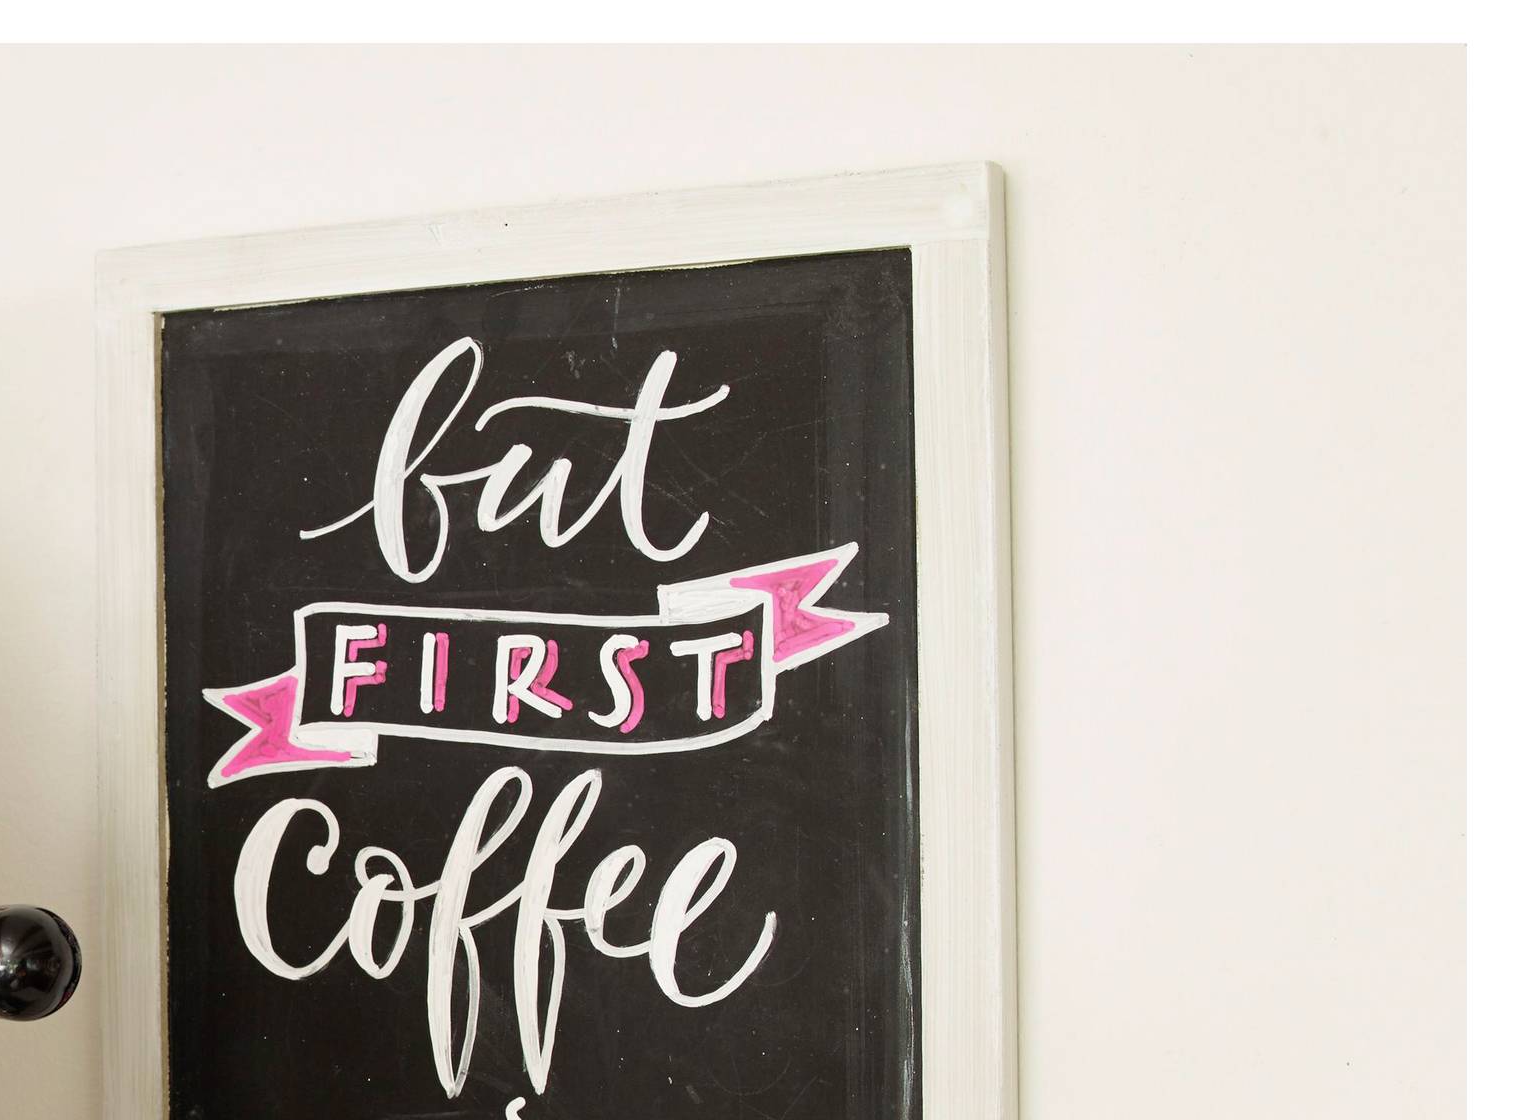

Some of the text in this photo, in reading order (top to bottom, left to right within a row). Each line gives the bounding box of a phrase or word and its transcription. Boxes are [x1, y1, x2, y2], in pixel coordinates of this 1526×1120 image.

[300, 336, 730, 583] but
[331, 623, 754, 733] FIRST
[234, 767, 777, 1098] Coffee
